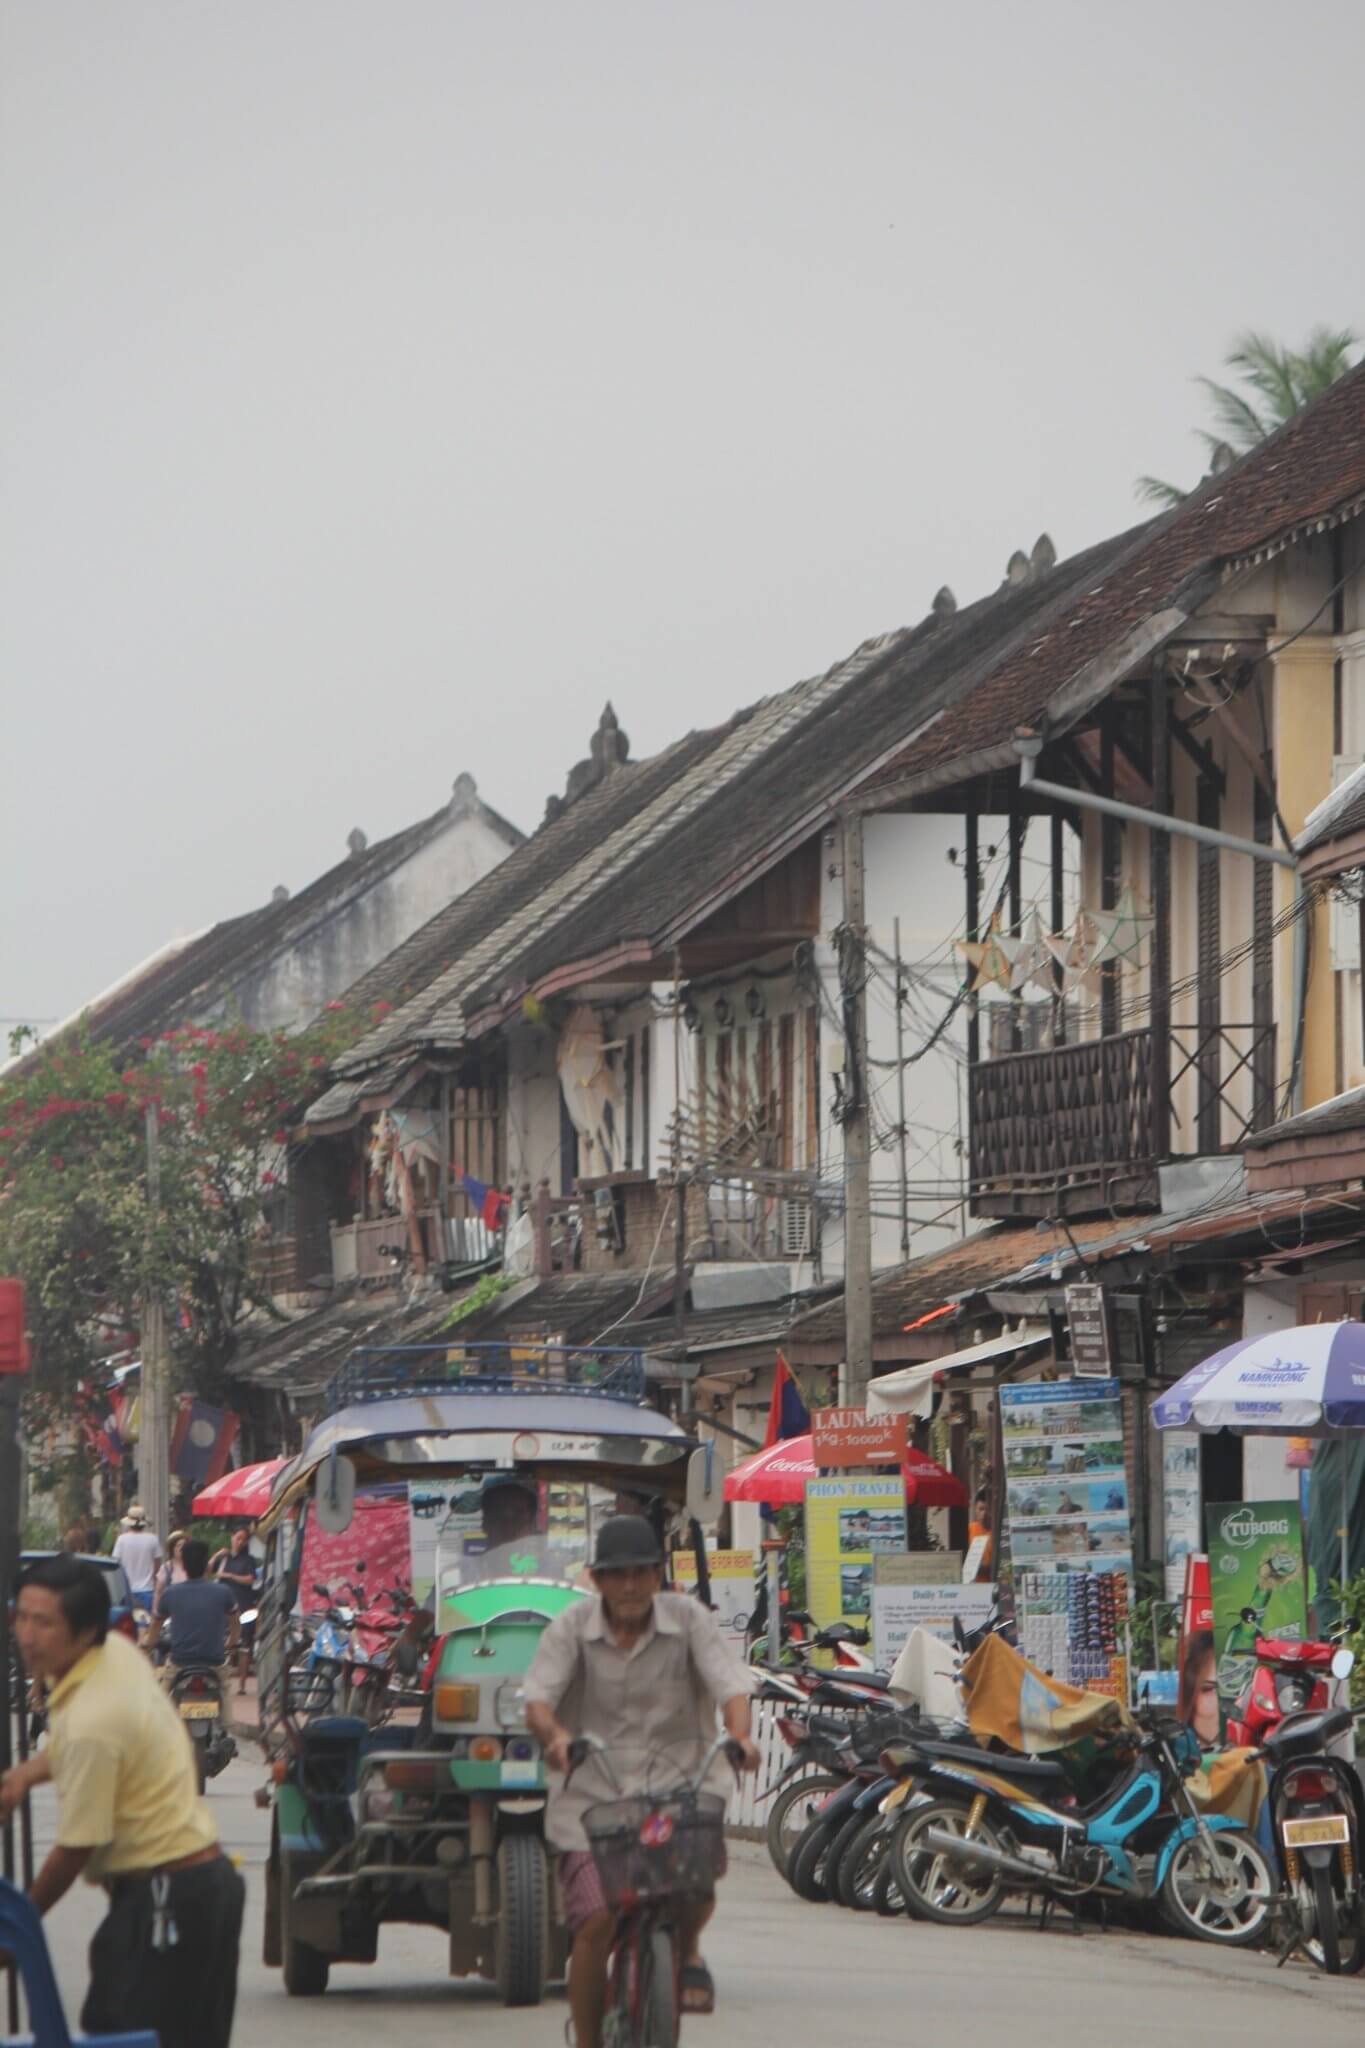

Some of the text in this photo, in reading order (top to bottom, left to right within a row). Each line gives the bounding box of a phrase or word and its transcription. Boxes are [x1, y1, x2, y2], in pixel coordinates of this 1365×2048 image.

[1238, 1372, 1307, 1383] NAMKHONG
[1234, 1401, 1282, 1413] NAMKHONG
[815, 1411, 898, 1429] LAUNDRY
[851, 1482, 900, 1496] TRAVEL
[1229, 1519, 1288, 1537] TUBORG
